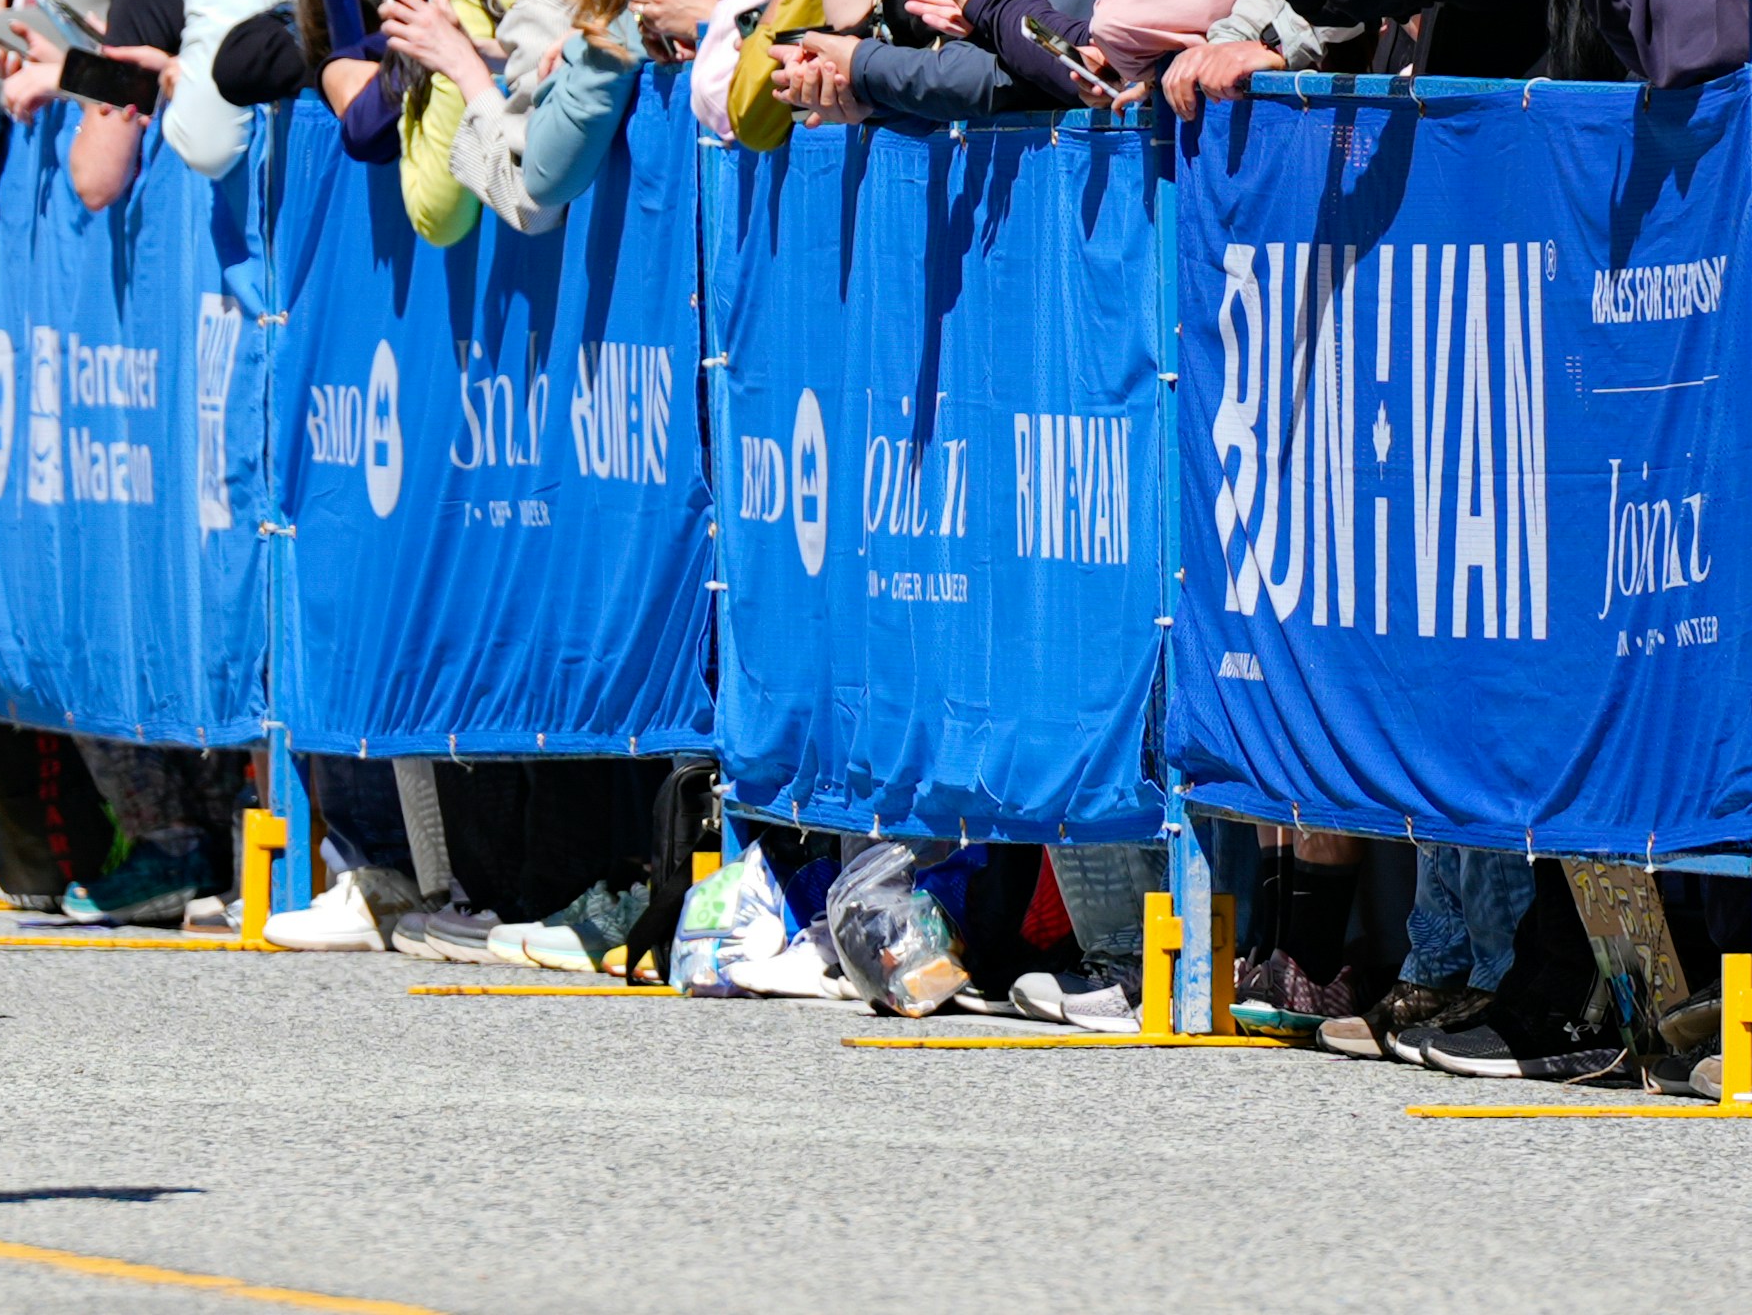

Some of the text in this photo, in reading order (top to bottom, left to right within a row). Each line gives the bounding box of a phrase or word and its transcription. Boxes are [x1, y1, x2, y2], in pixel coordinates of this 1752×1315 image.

[1635, 265, 1663, 322] FOR
[1013, 412, 1065, 560] RN
[1212, 241, 1548, 640] RUN VAN
